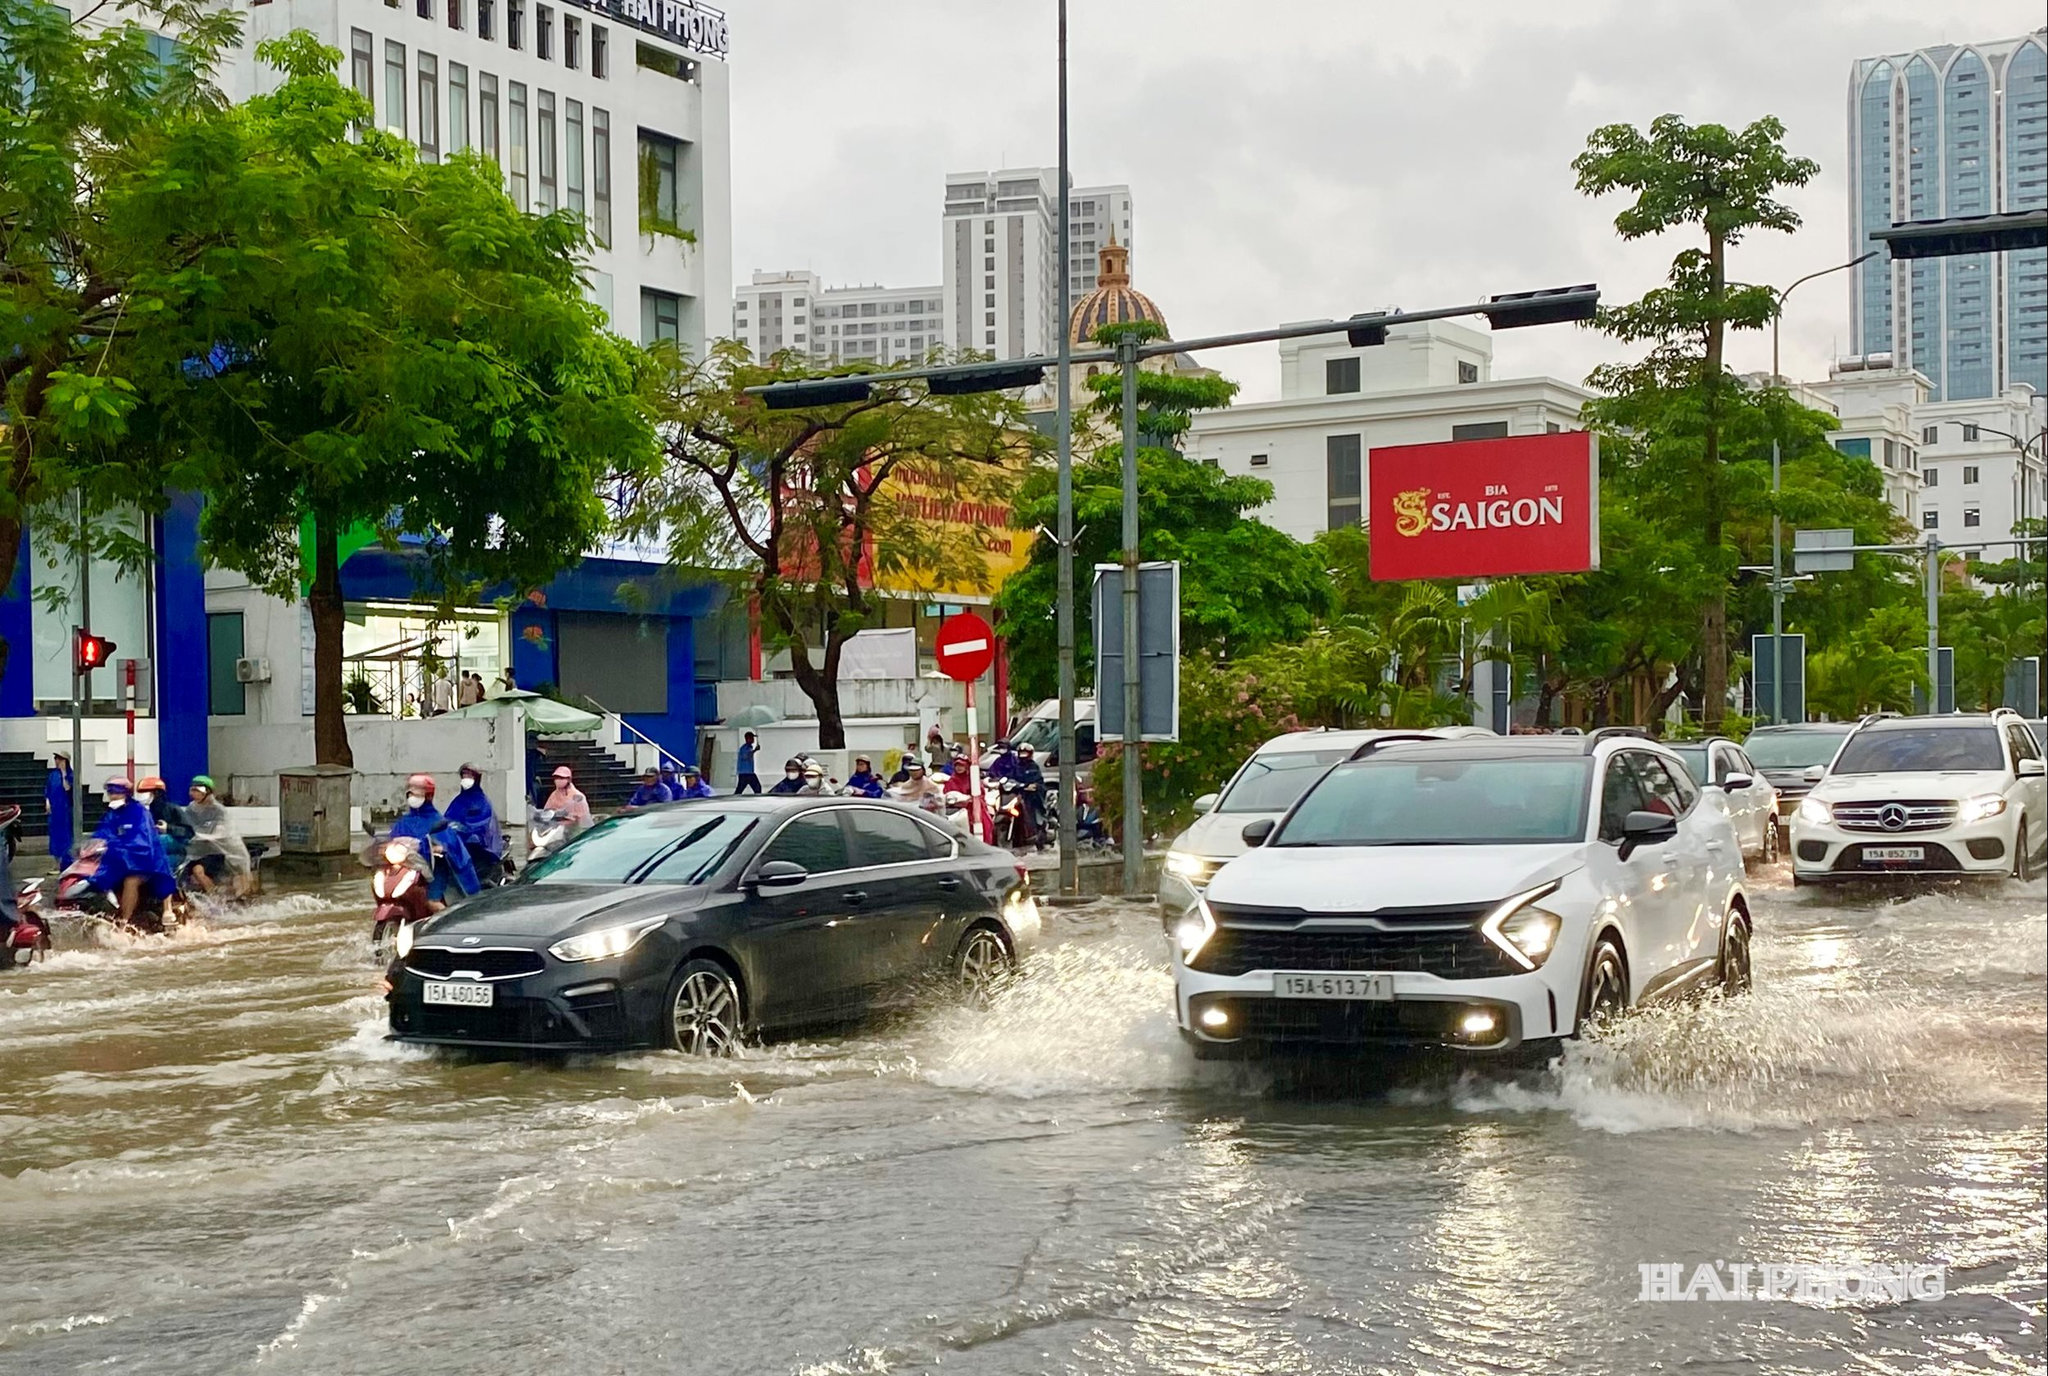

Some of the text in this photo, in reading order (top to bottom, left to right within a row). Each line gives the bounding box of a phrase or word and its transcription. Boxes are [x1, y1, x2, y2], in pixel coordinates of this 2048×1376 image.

[1485, 484, 1509, 497] BIA
[1431, 496, 1564, 532] SAIGON
[1286, 978, 1381, 996] 15A-613.71
